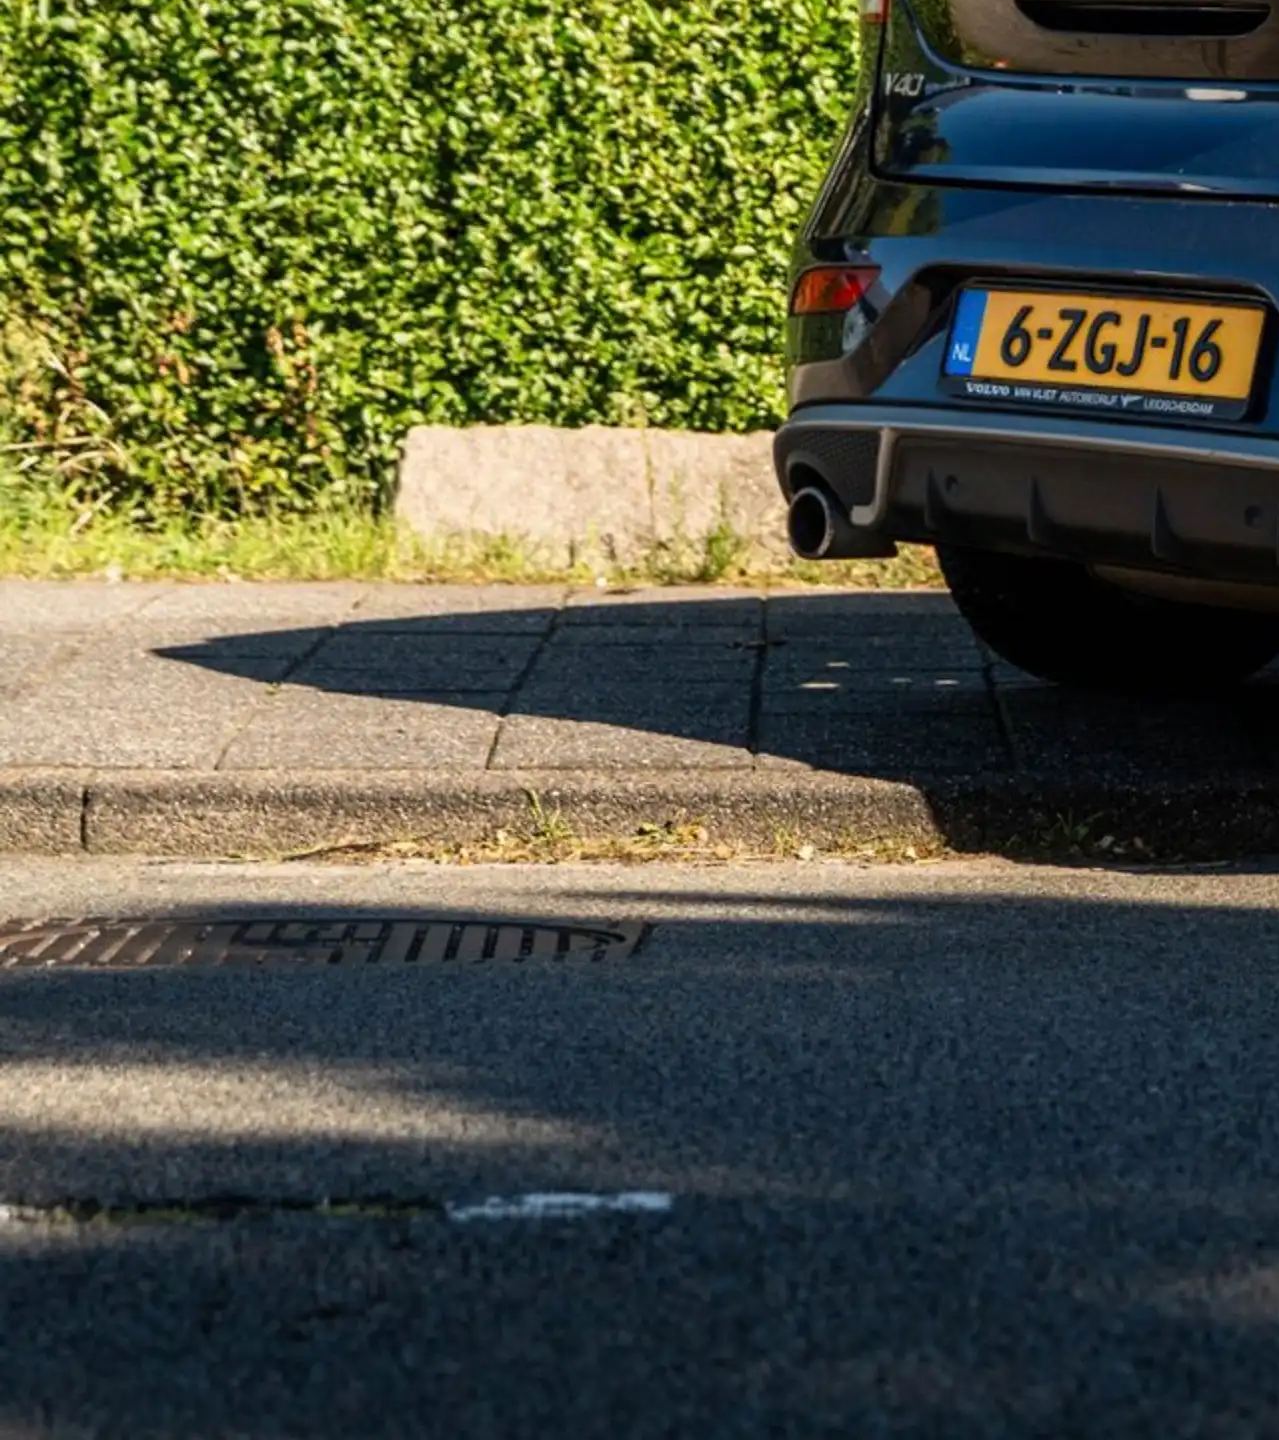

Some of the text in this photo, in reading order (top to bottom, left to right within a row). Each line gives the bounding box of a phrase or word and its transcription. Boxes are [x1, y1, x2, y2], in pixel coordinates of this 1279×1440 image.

[951, 342, 972, 364] NL
[999, 304, 1224, 383] 6-ZGJ-16
[966, 381, 1010, 397] VOLVO
